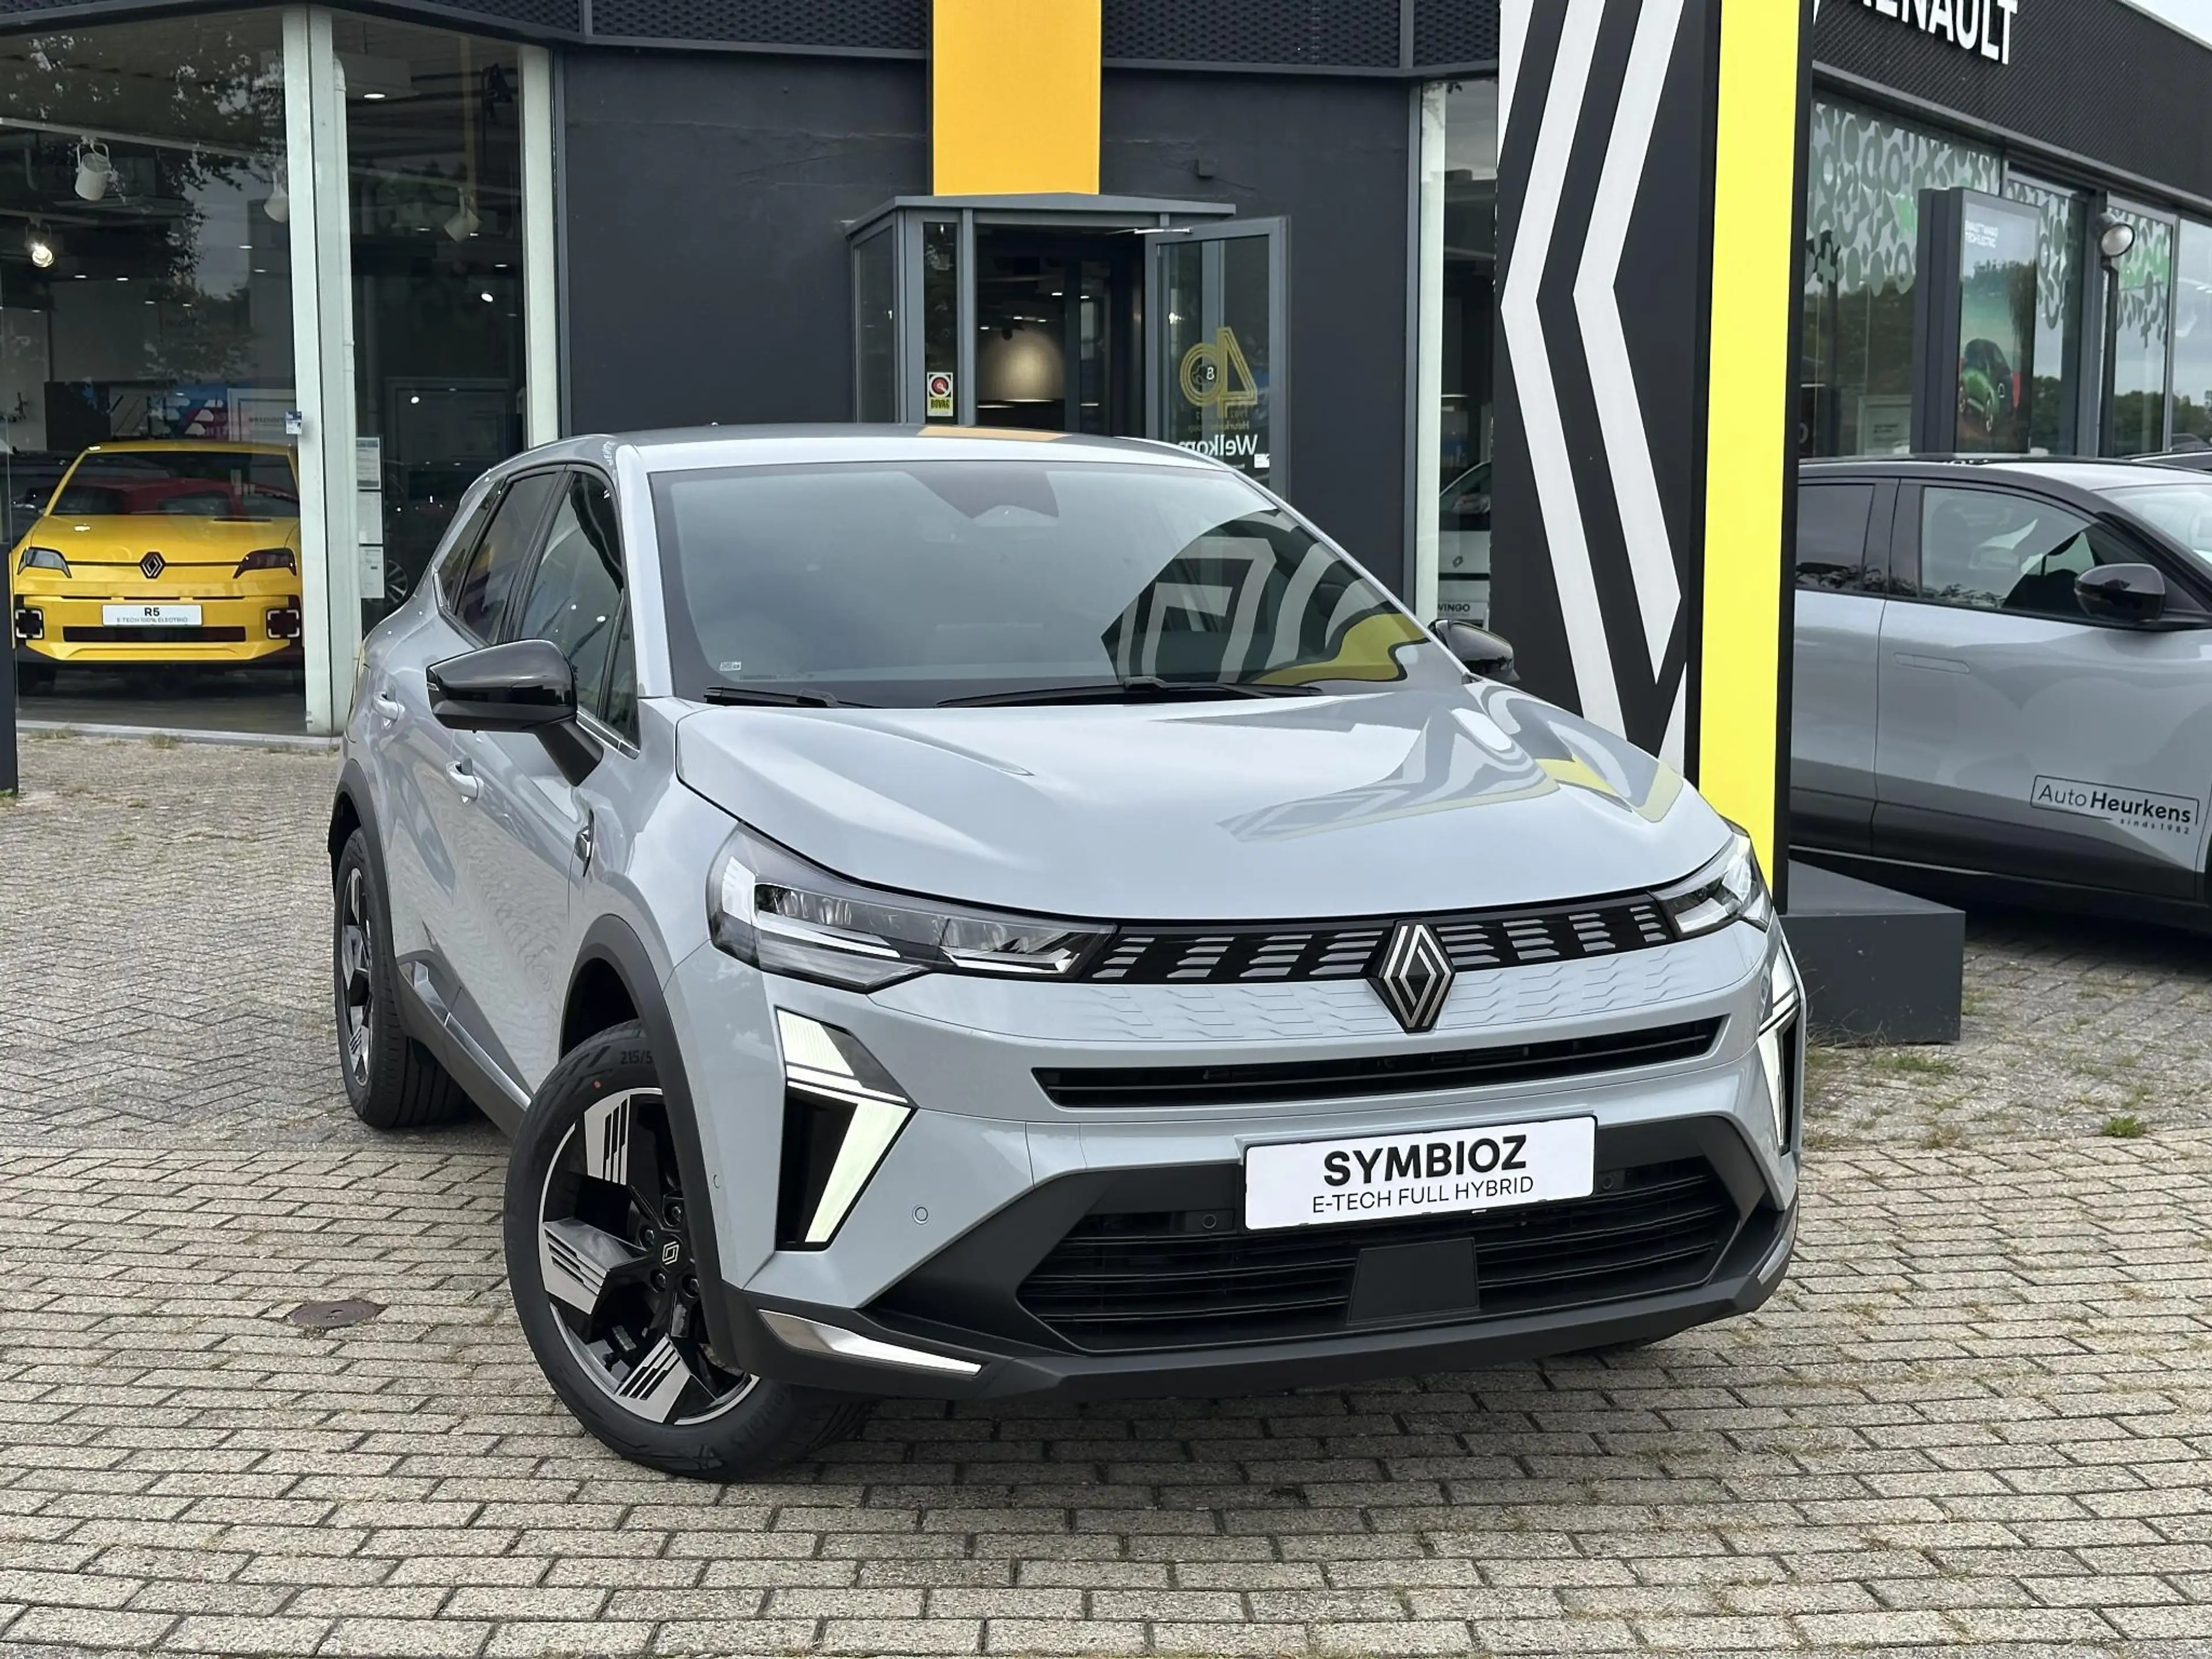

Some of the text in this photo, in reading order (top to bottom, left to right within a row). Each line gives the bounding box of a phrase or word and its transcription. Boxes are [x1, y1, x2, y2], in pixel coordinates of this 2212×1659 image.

[1862, 0, 2017, 65] AULT
[144, 607, 160, 616] R5
[2038, 784, 2191, 823] Auto Heurkens
[2120, 818, 2190, 835] sinds 1982
[1324, 1134, 1527, 1187] SYMBIOZ
[1313, 1176, 1534, 1214] E-TECH FULL HYBRID
